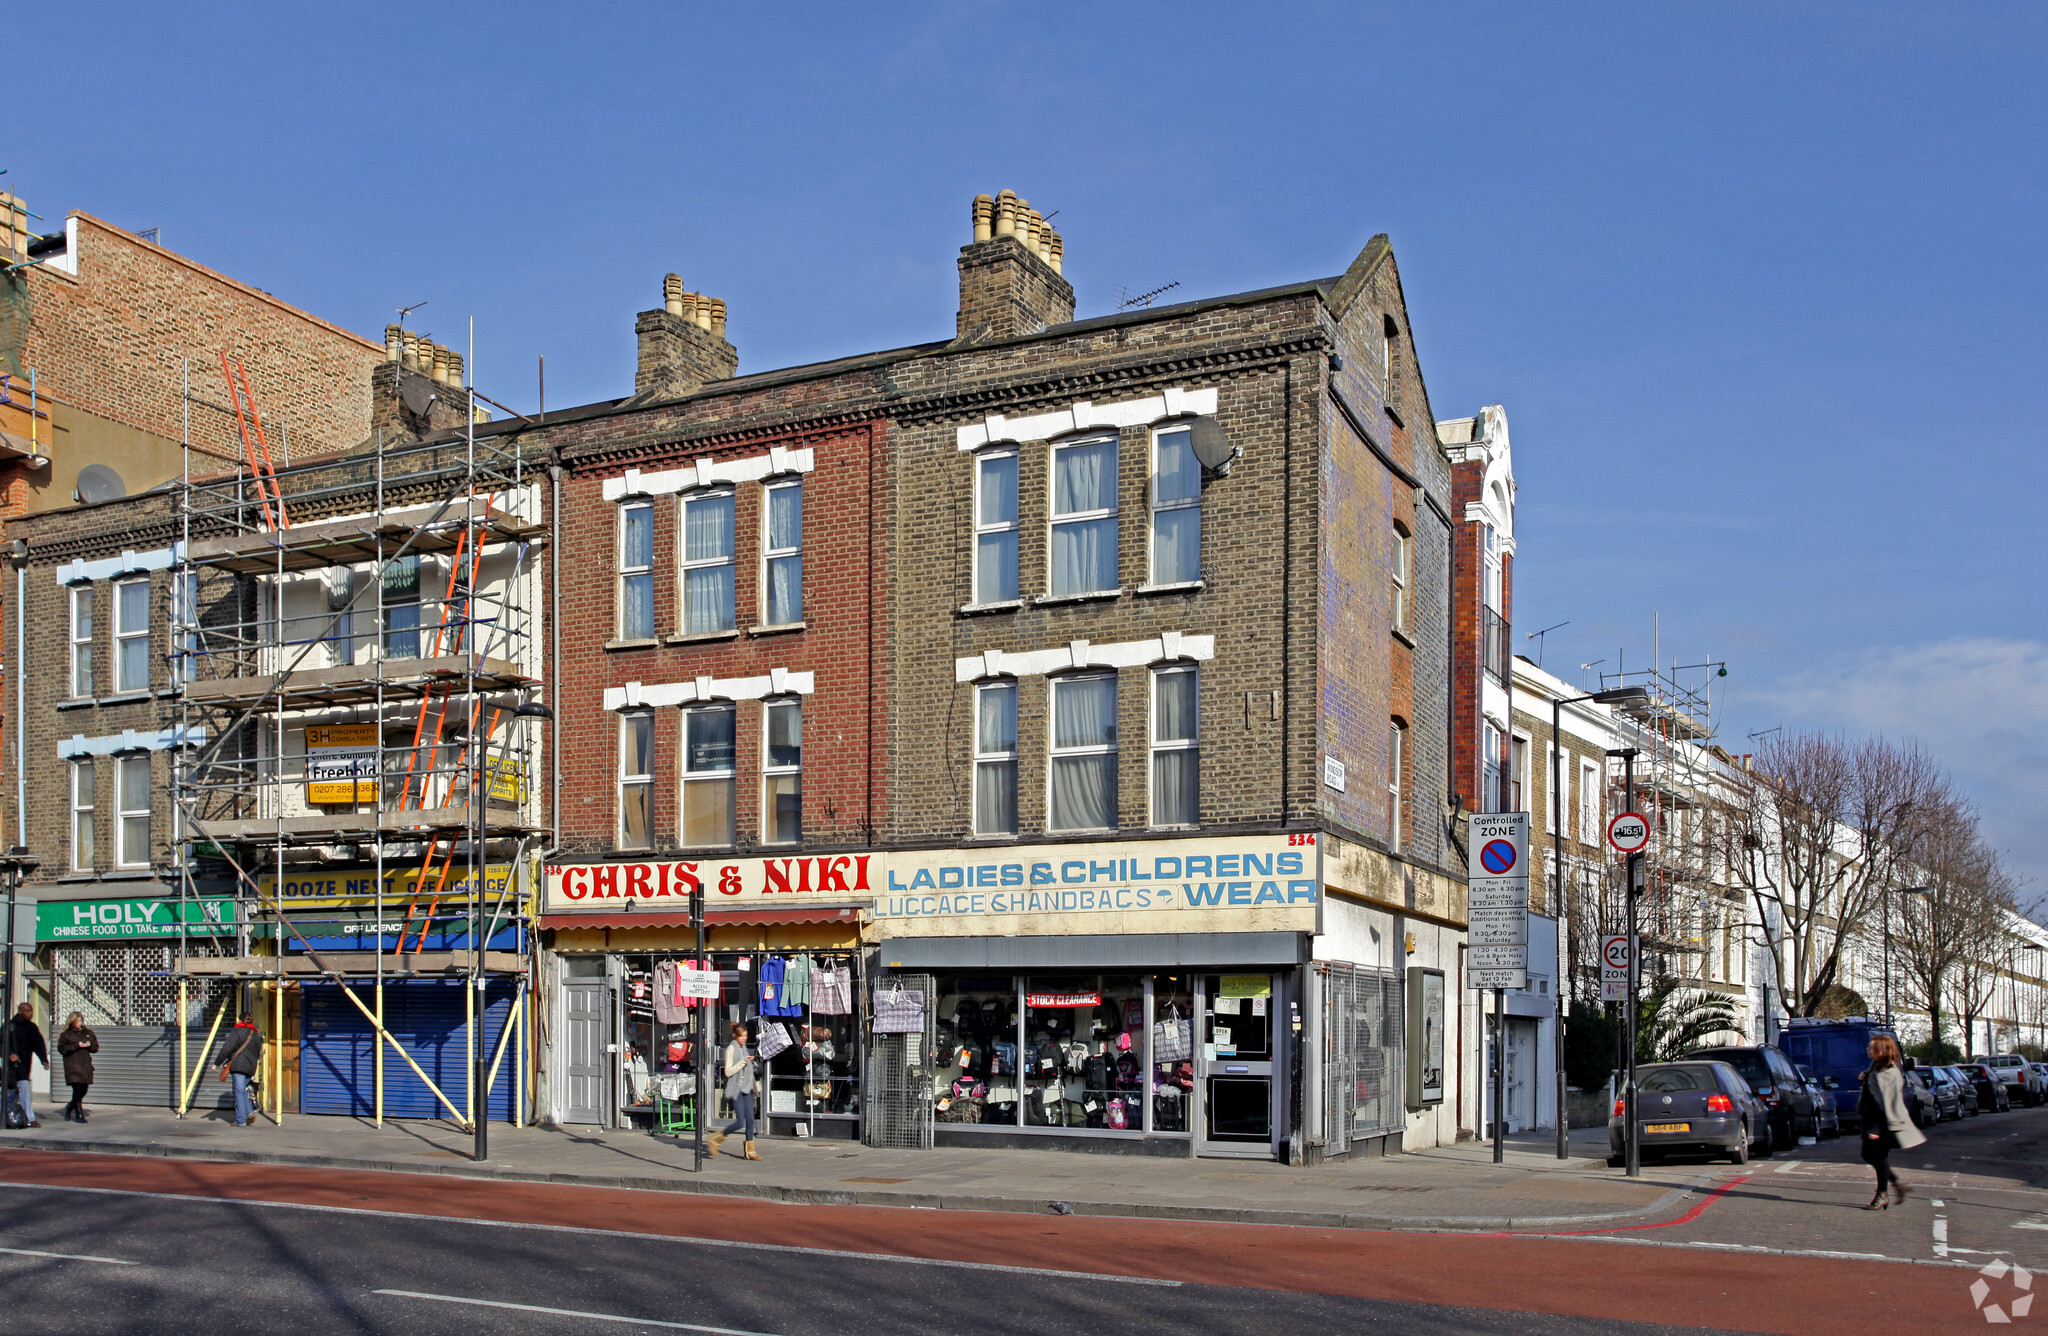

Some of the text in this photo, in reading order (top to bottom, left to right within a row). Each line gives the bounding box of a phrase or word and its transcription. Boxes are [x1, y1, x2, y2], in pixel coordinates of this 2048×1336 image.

[313, 764, 376, 779] Freehold
[314, 786, 334, 794] 0207
[336, 785, 352, 794] 286
[1474, 816, 1524, 825] Controlled
[1481, 826, 1516, 836] ZONE
[1288, 834, 1316, 846] 534
[544, 865, 562, 876] 536
[562, 854, 871, 900] CHRIS & NIKI
[346, 878, 396, 895] NEST
[1183, 880, 1316, 906] WEAR
[73, 902, 160, 925] HOLY
[53, 924, 182, 937] CHINESE FOOD TO TAKE AWA
[344, 924, 364, 934] OFF
[1610, 947, 1628, 960] 20
[1605, 970, 1627, 978] ZON
[1031, 993, 1098, 1005] STOCK CLEARANCE
